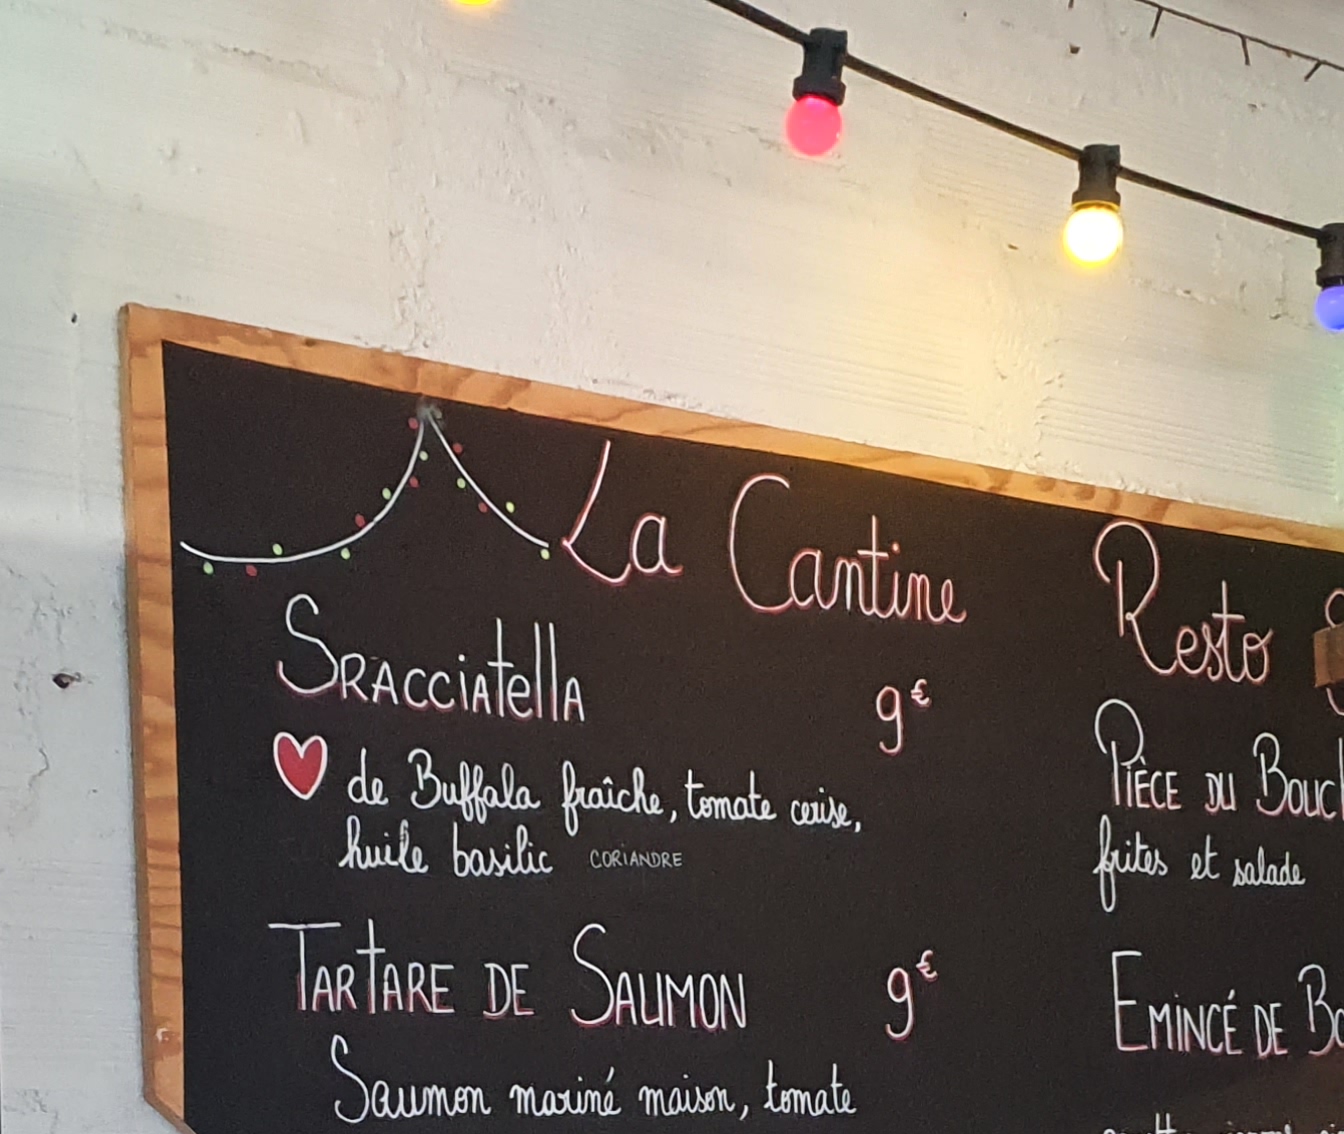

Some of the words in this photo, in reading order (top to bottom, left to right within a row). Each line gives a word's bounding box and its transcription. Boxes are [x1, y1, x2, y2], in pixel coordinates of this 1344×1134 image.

[561, 440, 683, 586] La
[727, 472, 968, 626] Cantine
[1093, 520, 1274, 684] Resto
[347, 747, 389, 806] de
[407, 748, 542, 819] Buffala
[684, 770, 777, 824] tomate
[1205, 772, 1237, 814] DU
[338, 816, 429, 873] huile
[453, 820, 555, 879] basilic
[589, 850, 682, 870] CORIANDRE
[1092, 814, 1168, 912] frites
[1191, 835, 1219, 881] et
[1233, 847, 1306, 887] salade
[483, 963, 534, 1018] DE
[570, 922, 746, 1029] SAUMON
[1255, 1003, 1288, 1057] DE
[330, 1034, 492, 1123] Saumon
[509, 1066, 622, 1118] mariné
[762, 1059, 857, 1118] tomate
